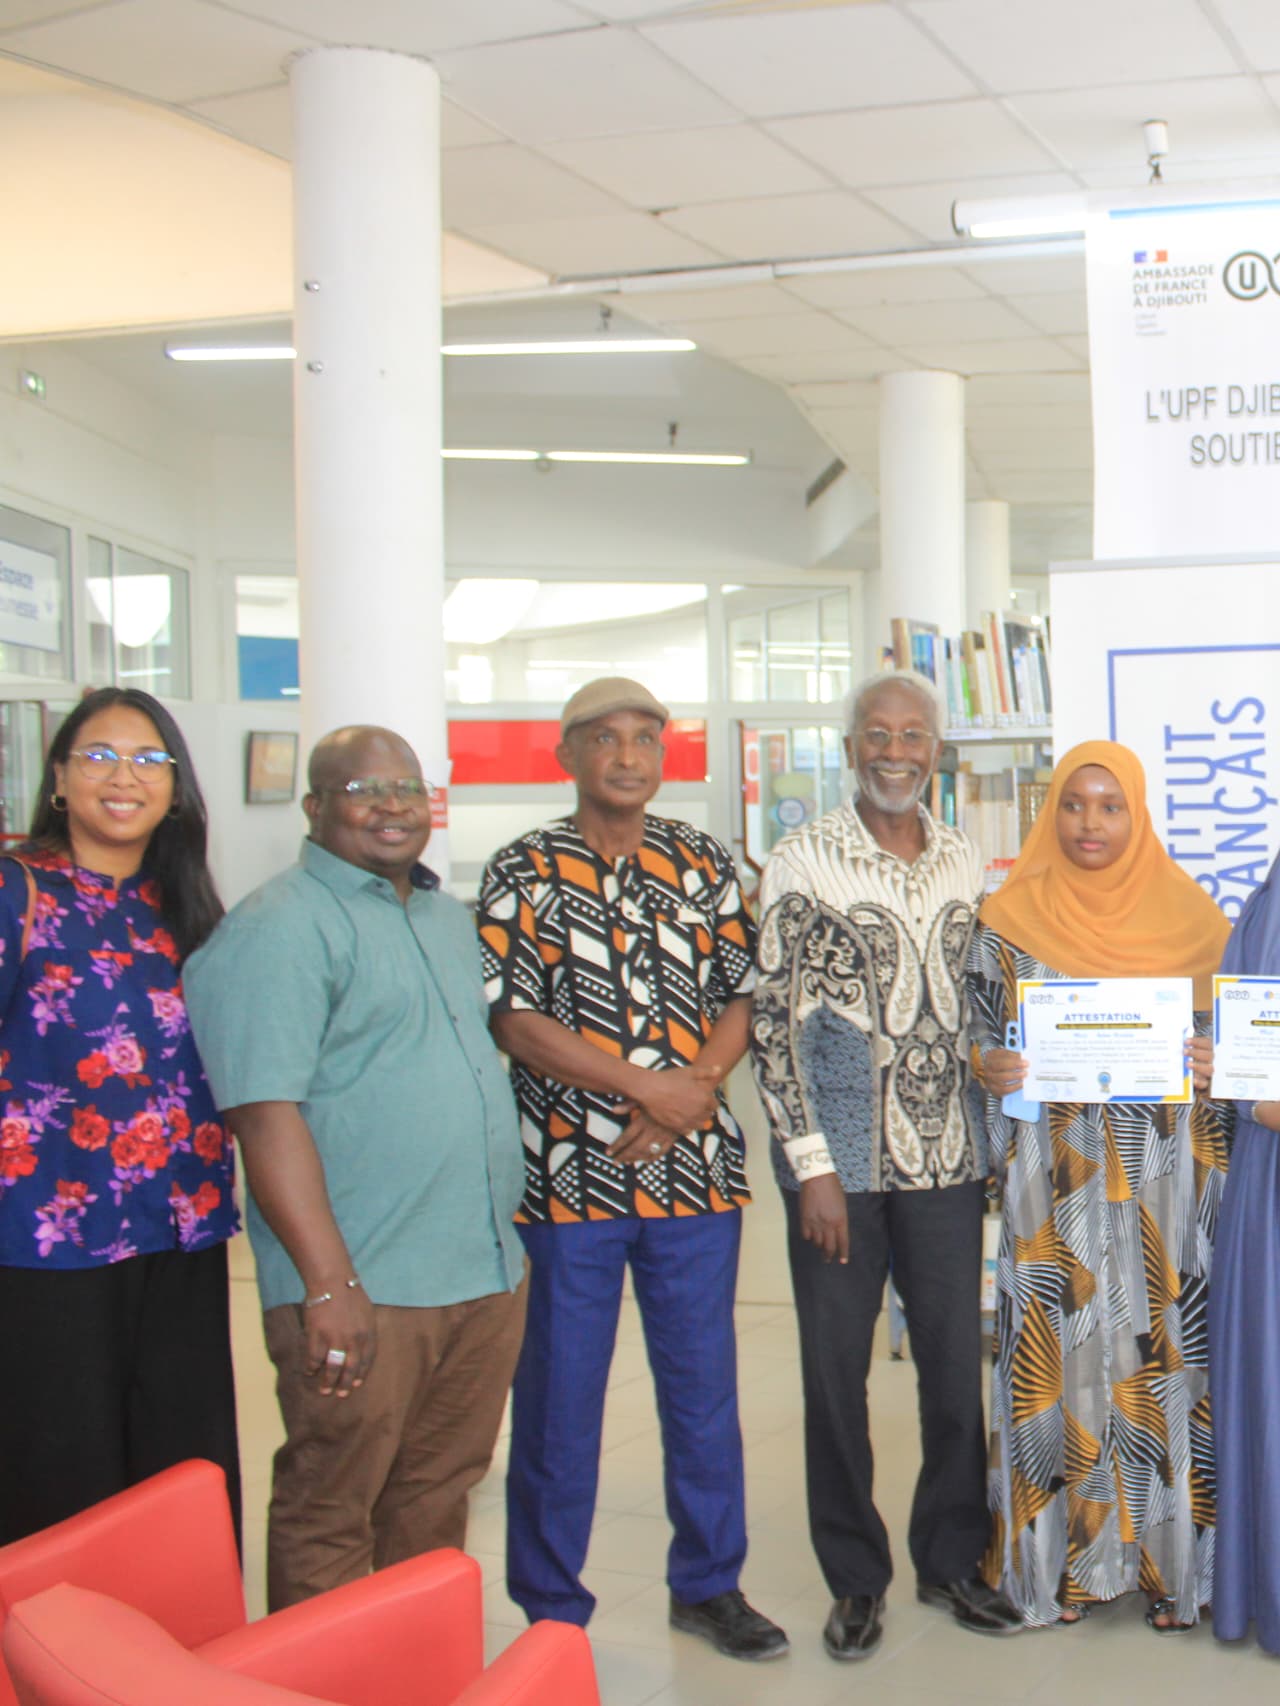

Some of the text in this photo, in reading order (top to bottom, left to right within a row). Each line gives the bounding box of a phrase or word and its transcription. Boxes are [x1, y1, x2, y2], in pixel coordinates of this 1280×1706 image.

[1133, 264, 1215, 279] AMBASSADE
[1133, 279, 1207, 294] DE FRANCE
[1146, 292, 1208, 309] DJIBOUTI
[1147, 386, 1217, 423] L'UPF
[1164, 725, 1220, 898] TITUT
[1063, 1013, 1142, 1022] ATTESTATION
